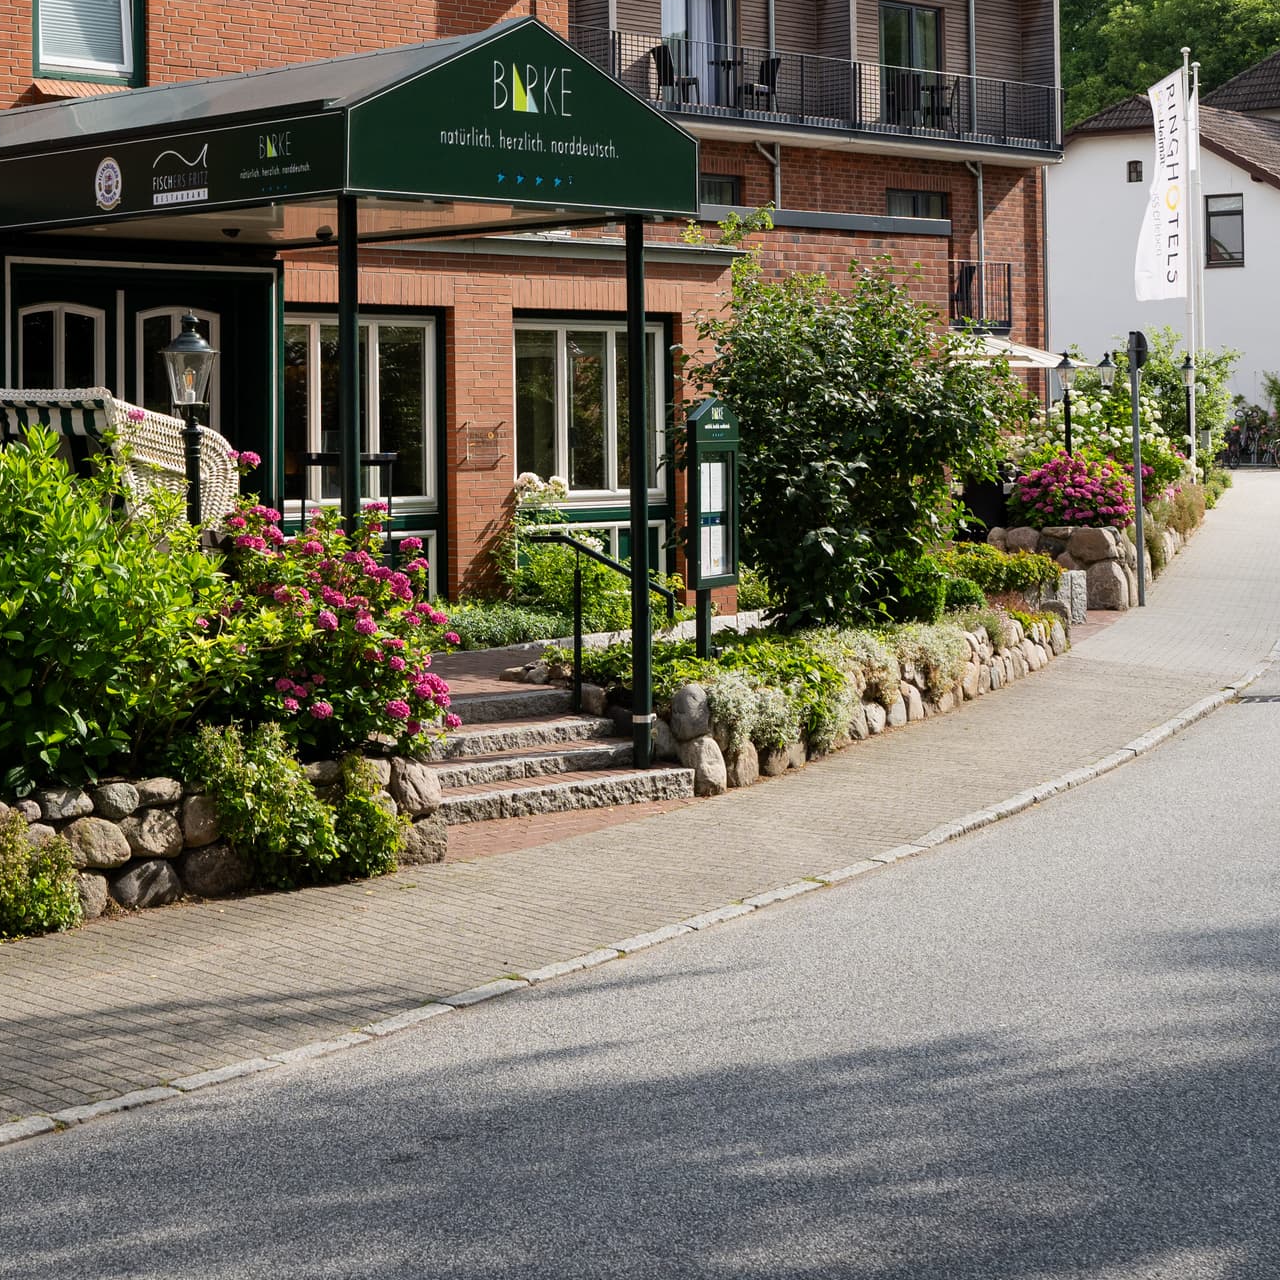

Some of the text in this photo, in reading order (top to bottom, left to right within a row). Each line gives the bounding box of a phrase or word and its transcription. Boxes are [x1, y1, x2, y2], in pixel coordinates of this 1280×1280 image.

[440, 126, 620, 159] natürlich. herzlich. norddeutsch.
[152, 170, 208, 191] FISCHERS FRITZ
[1164, 82, 1180, 284] RINGHOTELS
[154, 190, 207, 204] RESTAURANT
